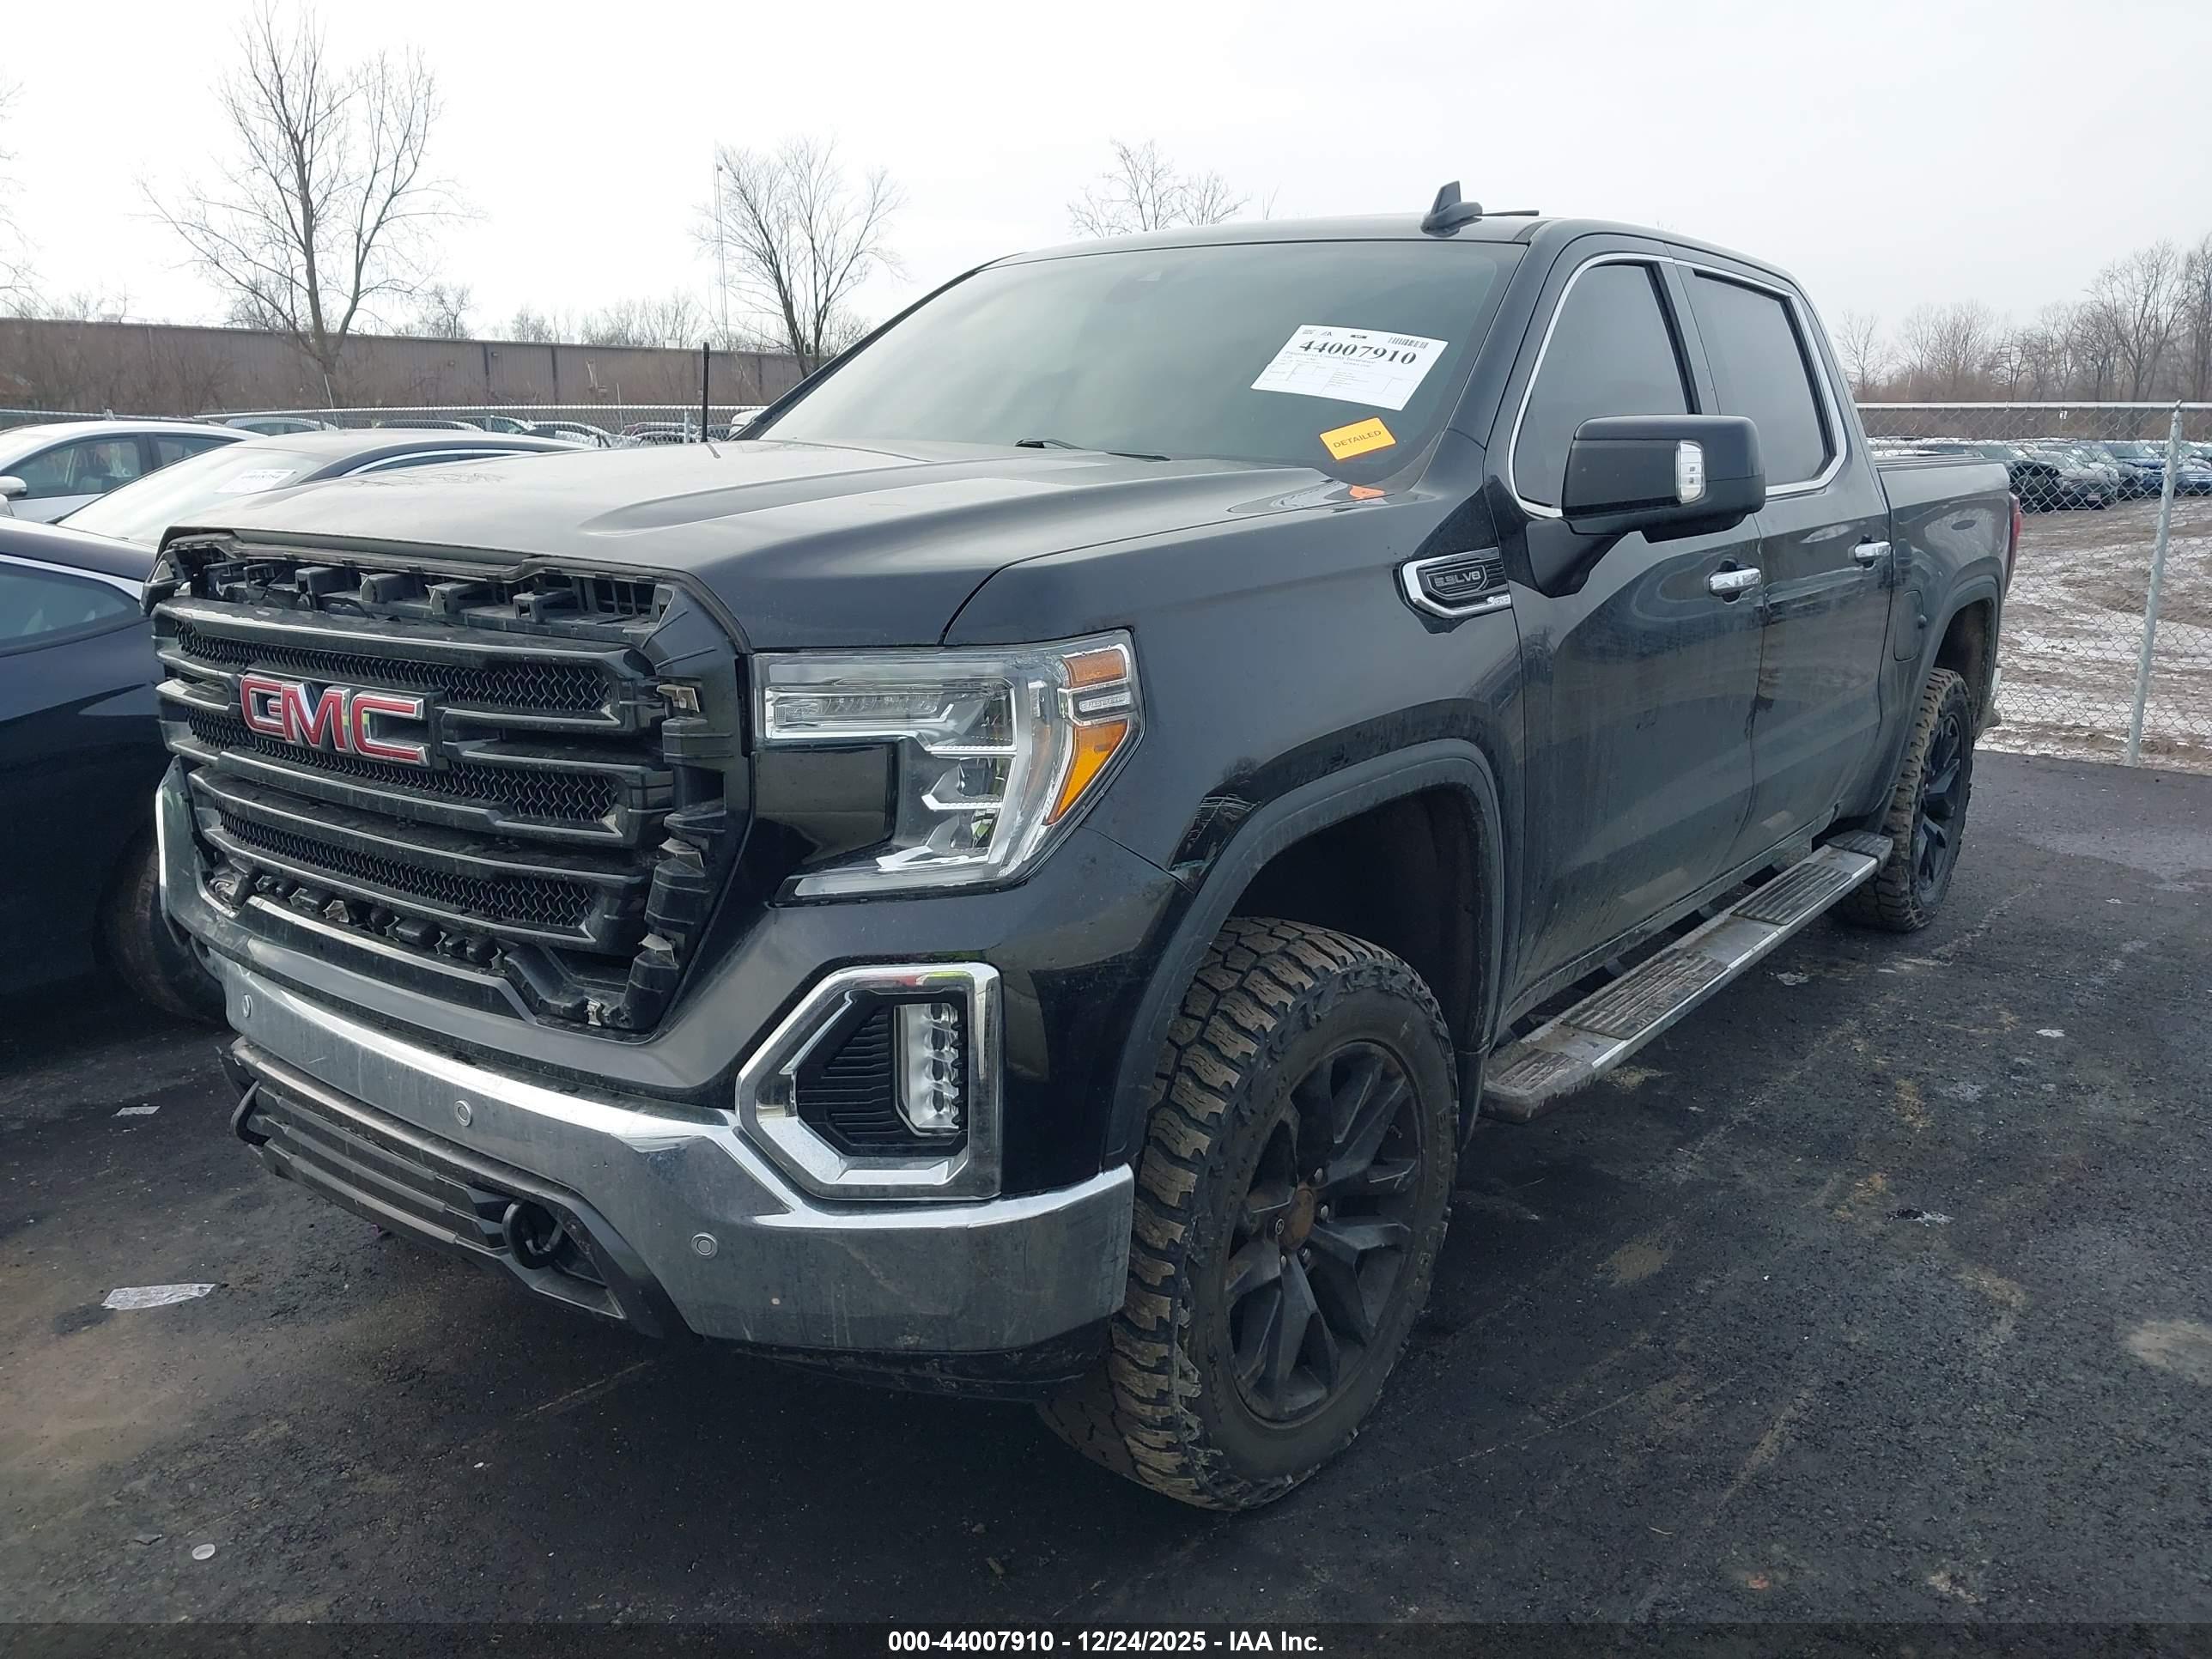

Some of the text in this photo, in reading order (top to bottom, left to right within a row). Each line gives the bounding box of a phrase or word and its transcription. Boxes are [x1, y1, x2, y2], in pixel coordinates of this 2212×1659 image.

[1298, 340, 1417, 365] 44007910
[1333, 430, 1382, 448] DETAILED
[240, 673, 430, 767] GMC
